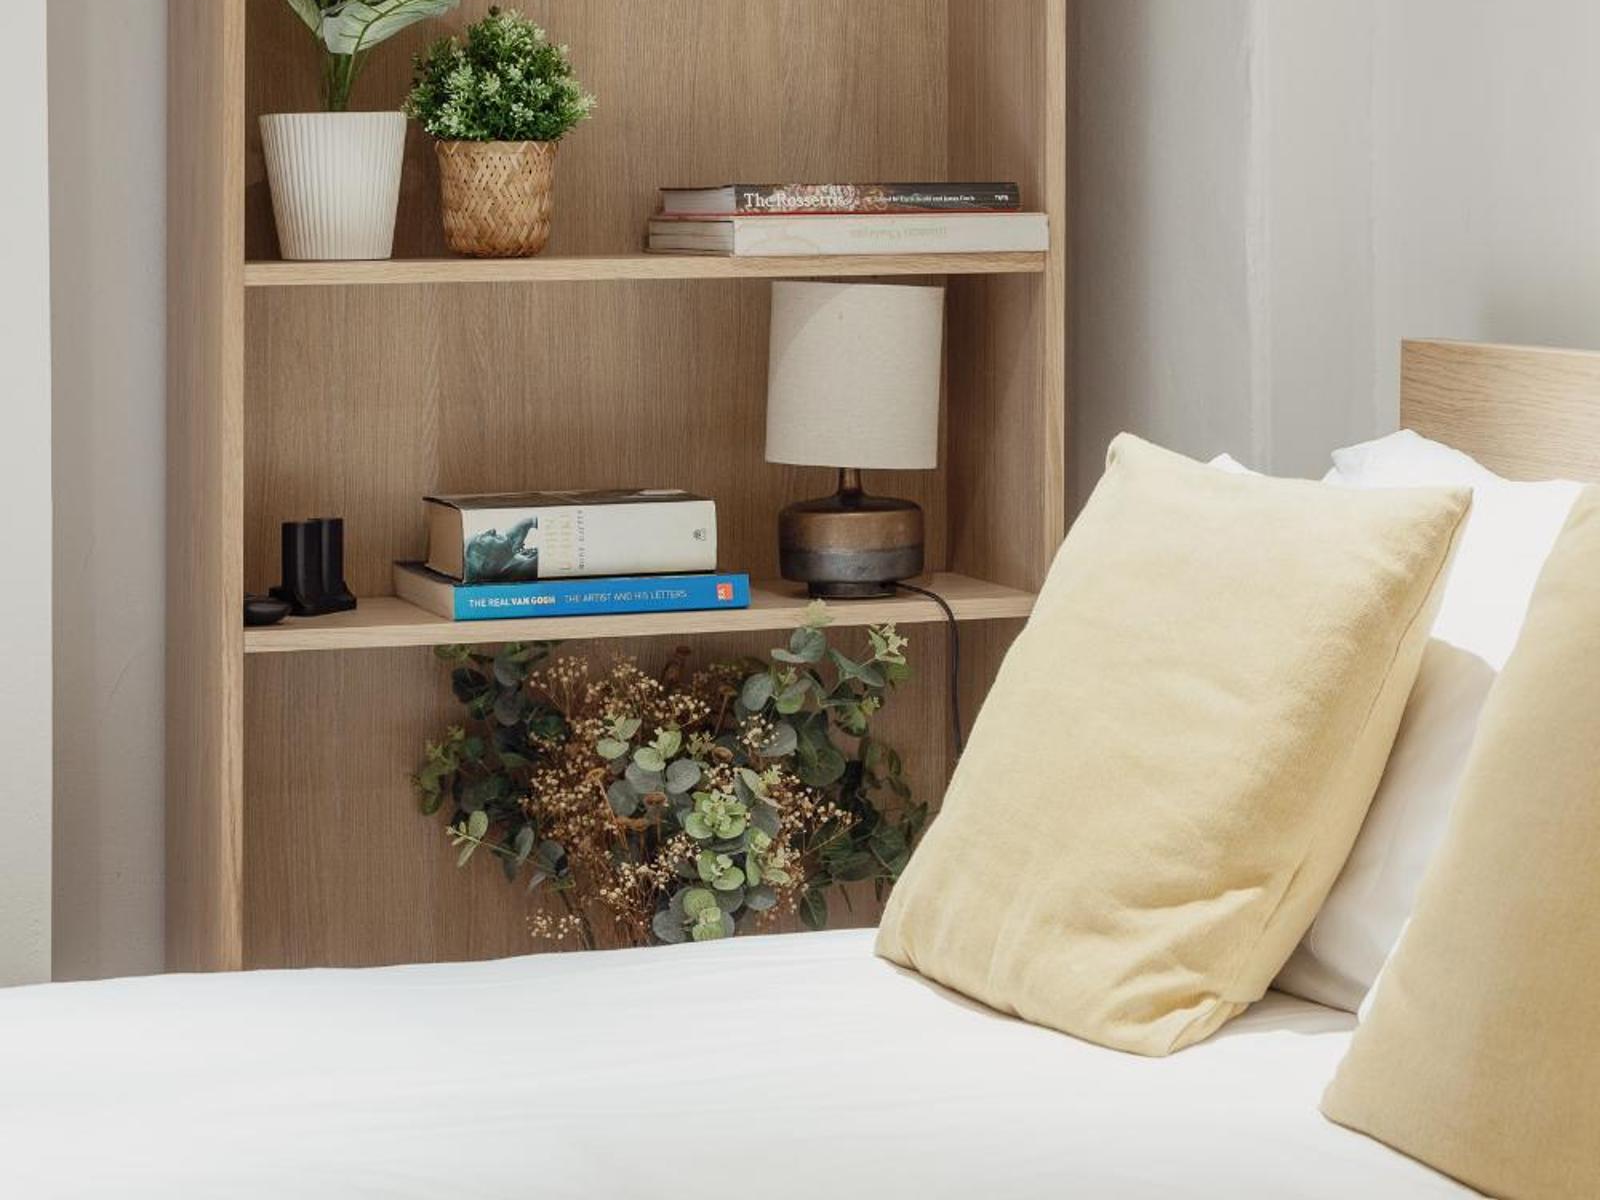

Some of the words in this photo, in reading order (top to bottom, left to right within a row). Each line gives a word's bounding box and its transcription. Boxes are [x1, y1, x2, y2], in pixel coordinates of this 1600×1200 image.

[743, 192, 774, 209] The
[469, 599, 487, 609] THE
[487, 598, 510, 608] REAL
[511, 596, 531, 606] VAN
[531, 596, 556, 605] GOGH
[564, 594, 582, 604] THE
[583, 593, 612, 603] ARTIST
[650, 588, 688, 600] LETTERS
